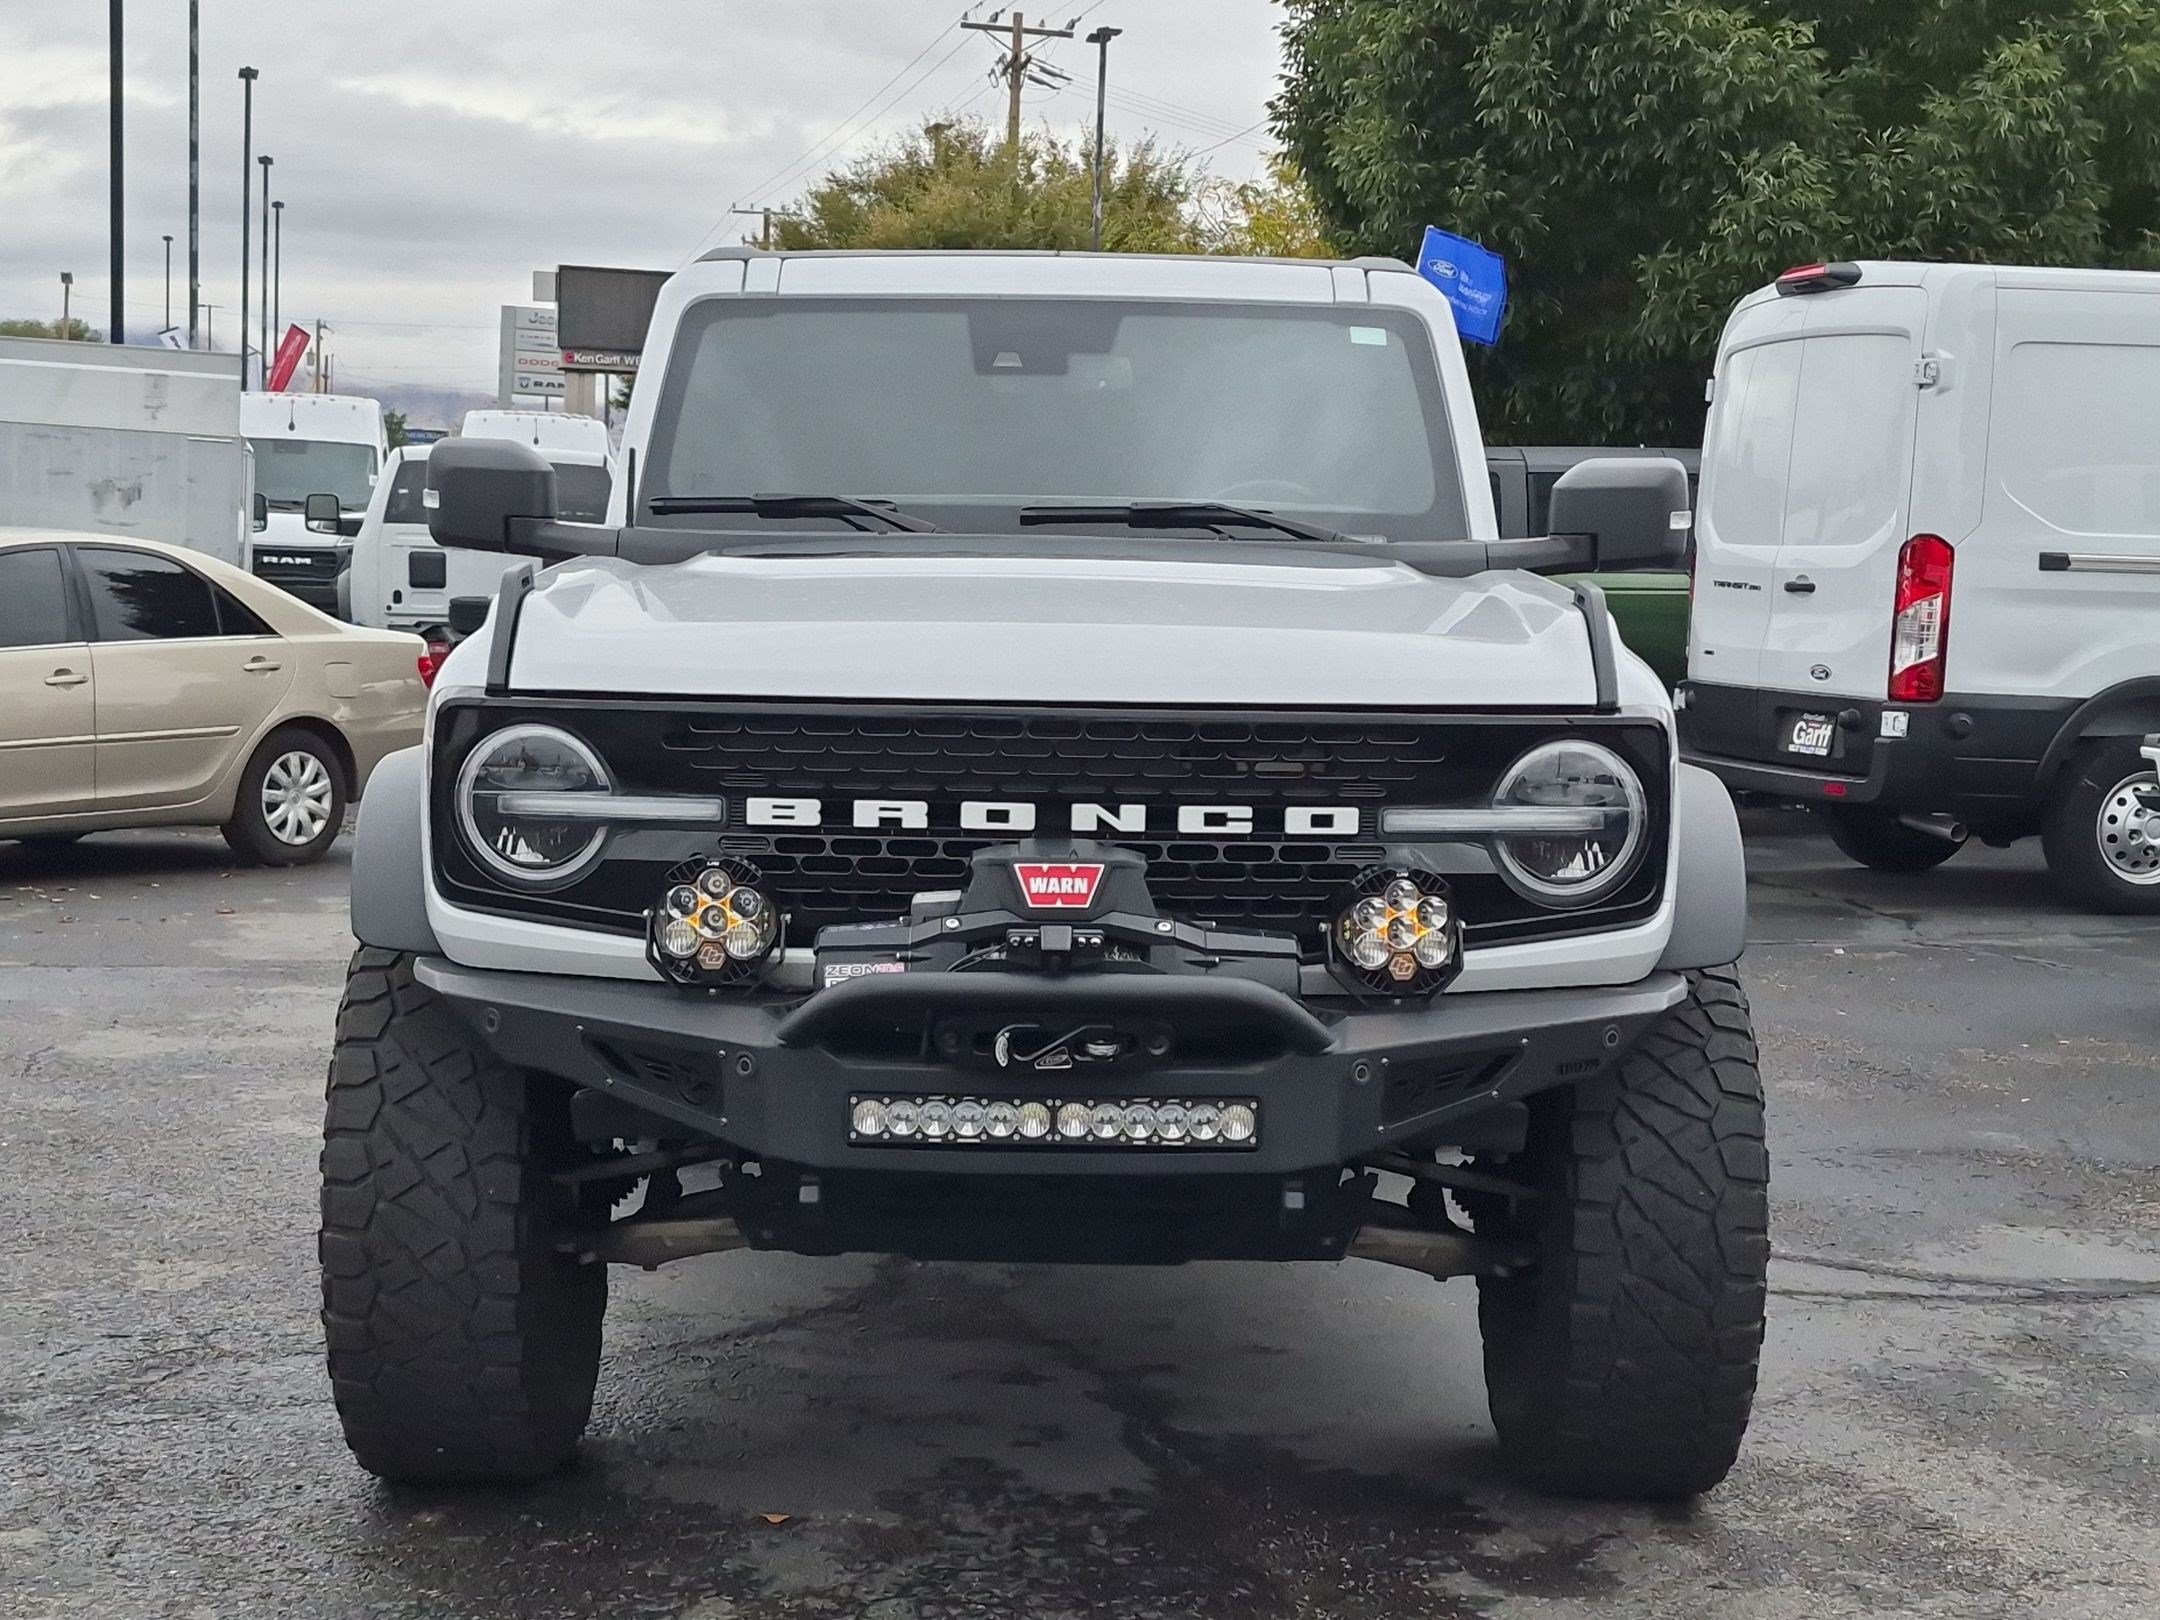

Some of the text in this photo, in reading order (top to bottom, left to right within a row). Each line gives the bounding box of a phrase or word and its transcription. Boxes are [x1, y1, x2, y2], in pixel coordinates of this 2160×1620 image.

[528, 312, 555, 325] Jee
[518, 358, 559, 367] DODG
[574, 353, 641, 366] Ken Garff WE
[262, 555, 312, 565] RAM
[1793, 720, 1832, 747] Garff
[745, 797, 1360, 836] BRONCO
[1029, 876, 1088, 894] WARN
